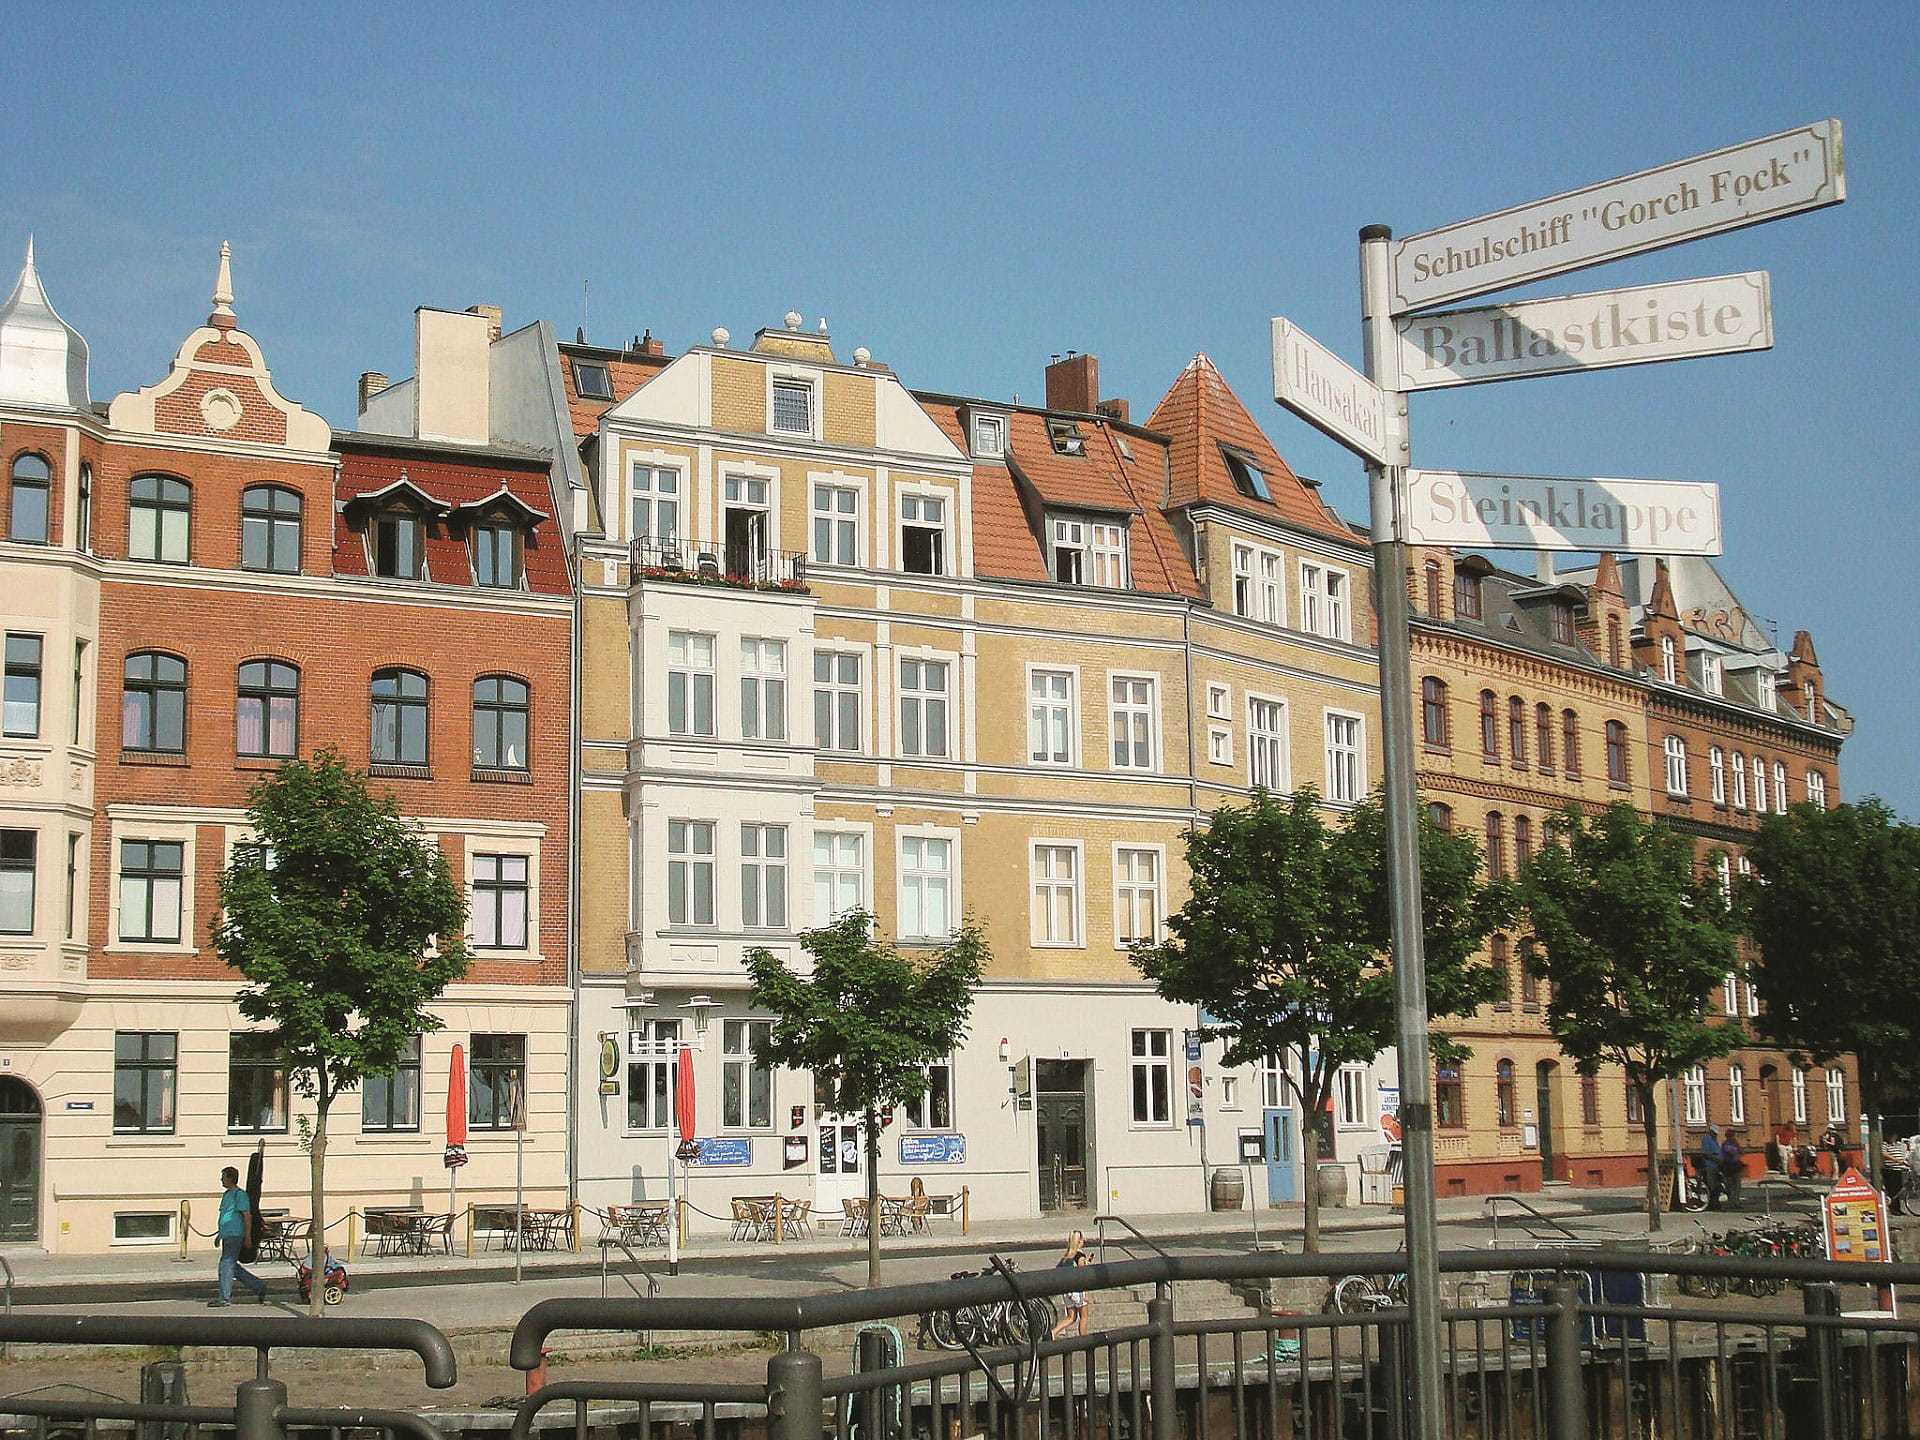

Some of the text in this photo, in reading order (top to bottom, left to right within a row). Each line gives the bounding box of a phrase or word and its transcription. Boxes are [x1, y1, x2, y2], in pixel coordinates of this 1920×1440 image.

[1413, 211, 1574, 285] Schulschiff
[1418, 298, 1743, 371] Ballastkiste
[1294, 341, 1378, 441] Hansakai
[1429, 481, 1697, 546] Steinklappe
